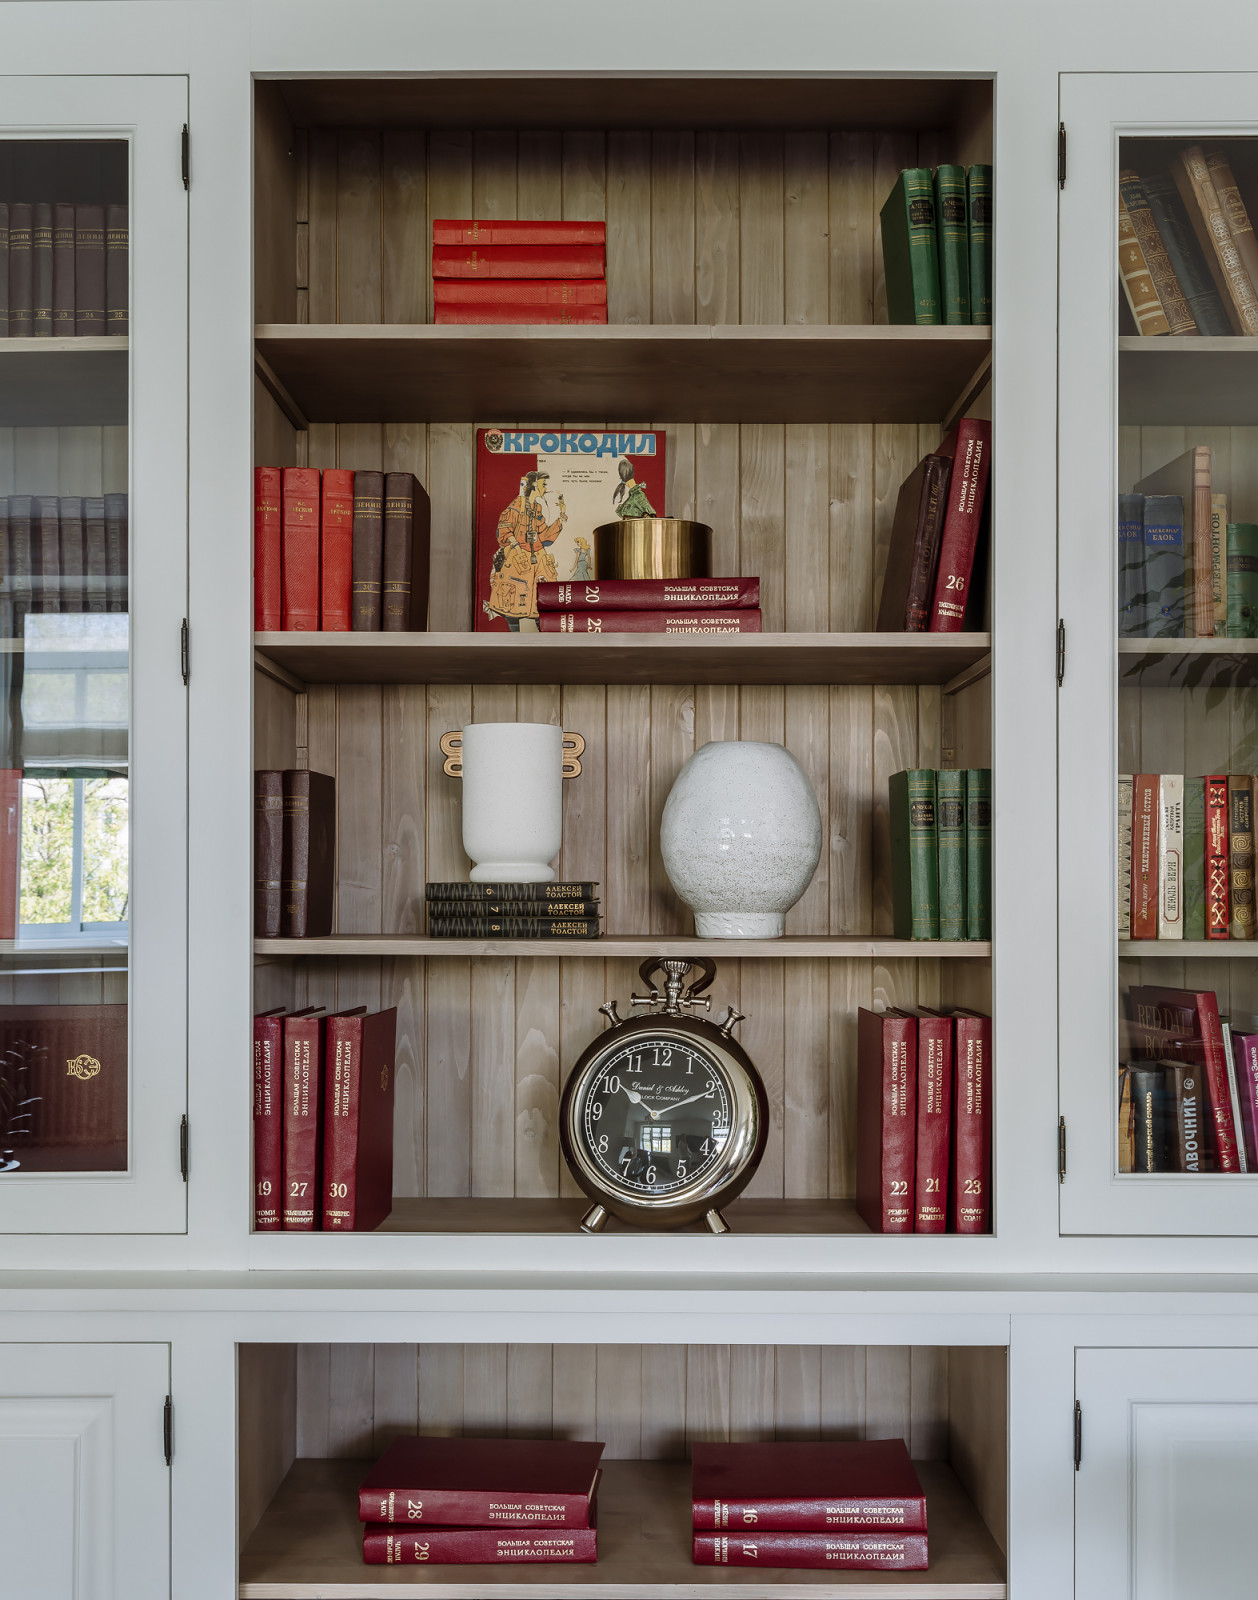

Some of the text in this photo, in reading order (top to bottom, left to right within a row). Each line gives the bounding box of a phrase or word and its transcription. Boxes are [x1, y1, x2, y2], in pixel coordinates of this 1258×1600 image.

[504, 433, 656, 458] КРОКОДИЛ
[959, 439, 974, 512] БОЛЬШАЯ СОВЕТСКАЯ
[967, 440, 984, 514] ЭНЦИКЛОПЕДИЯ
[946, 575, 965, 591] 26
[585, 586, 600, 603] 20
[588, 618, 602, 633] 25
[1142, 789, 1152, 873] ТАИНСТВЕННЫЙ ОСТРОВ
[1168, 861, 1176, 911] ЖЮЛЬ ВЕРН
[335, 1041, 343, 1080] СОВЕТСКАЯ
[626, 1054, 643, 1073] 11
[652, 1048, 672, 1067] 12
[685, 1056, 694, 1074] 1
[302, 1040, 310, 1116] ЭНЦИКЛОПЕДИЯ
[342, 1041, 351, 1117] ЭНЦИКЛОПЕДИЯ
[602, 1076, 620, 1094] 10
[632, 1081, 655, 1091] Daniel
[656, 1085, 664, 1095] &
[704, 1080, 715, 1099] 2
[592, 1102, 603, 1120] 9
[711, 1110, 722, 1128] 3
[598, 1135, 609, 1153] 8
[700, 1138, 710, 1155] 4
[621, 1158, 632, 1177] 7
[646, 1166, 657, 1184] 6
[676, 1160, 687, 1178] 5
[257, 1181, 272, 1196] 19
[290, 1182, 308, 1197] 27
[329, 1182, 348, 1198] 30
[890, 1181, 908, 1195] 22
[925, 1178, 940, 1192] 21
[964, 1179, 982, 1194] 23
[408, 1500, 423, 1519] 28
[489, 1512, 566, 1521] ЭНЦИКЛОПЕДИЯ
[525, 1504, 566, 1512] СОВЕТСКАЯ
[743, 1508, 758, 1523] 16
[826, 1516, 905, 1524] ЭНЦИКЛОПЕДИЯ
[414, 1542, 430, 1561] 29
[743, 1544, 758, 1558] 17
[826, 1552, 905, 1560] ЭНЦИКЛОПЕДИЯ
